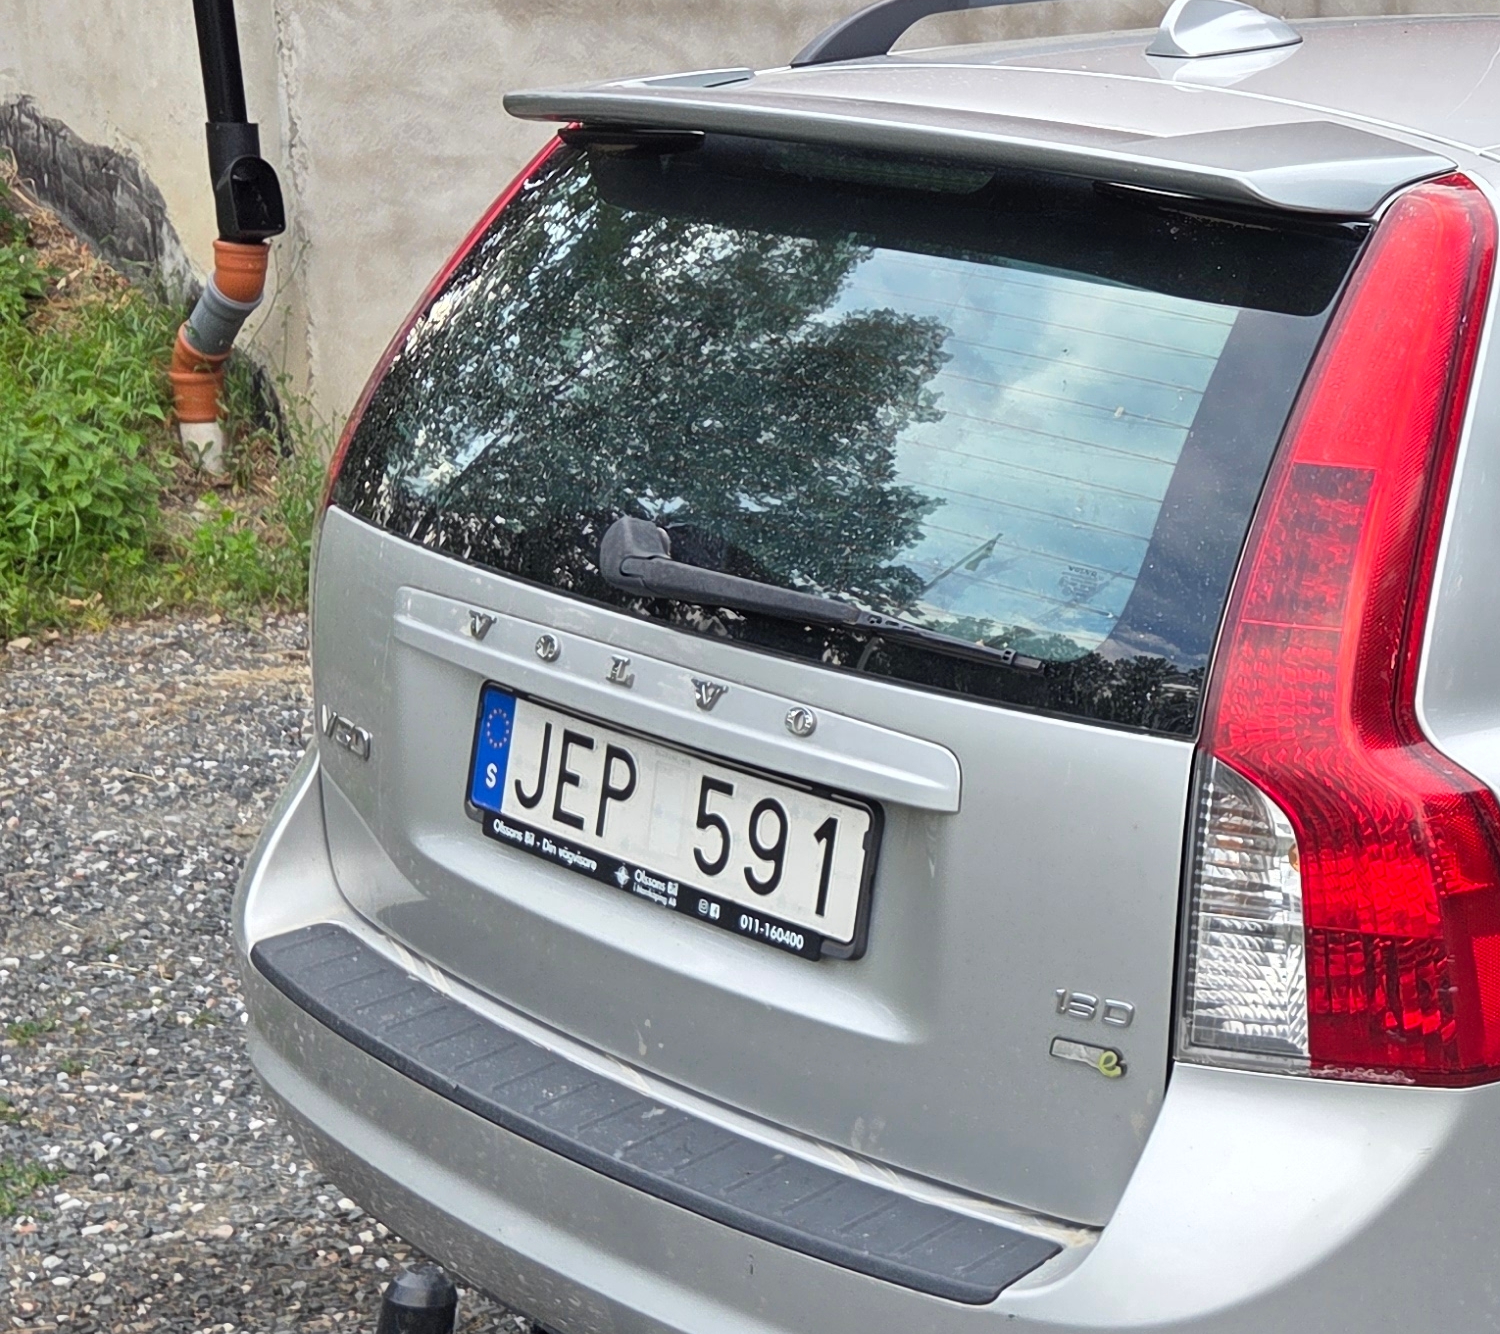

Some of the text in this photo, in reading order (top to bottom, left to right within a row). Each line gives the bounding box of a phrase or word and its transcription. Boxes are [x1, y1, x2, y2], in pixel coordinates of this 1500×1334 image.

[469, 609, 818, 738] VOLVO
[485, 763, 498, 789] S
[493, 818, 523, 843] Olssons
[542, 838, 557, 855] Din
[514, 722, 838, 917] JEP 591
[634, 868, 666, 893] Olssons
[739, 914, 805, 951] 011-160400
